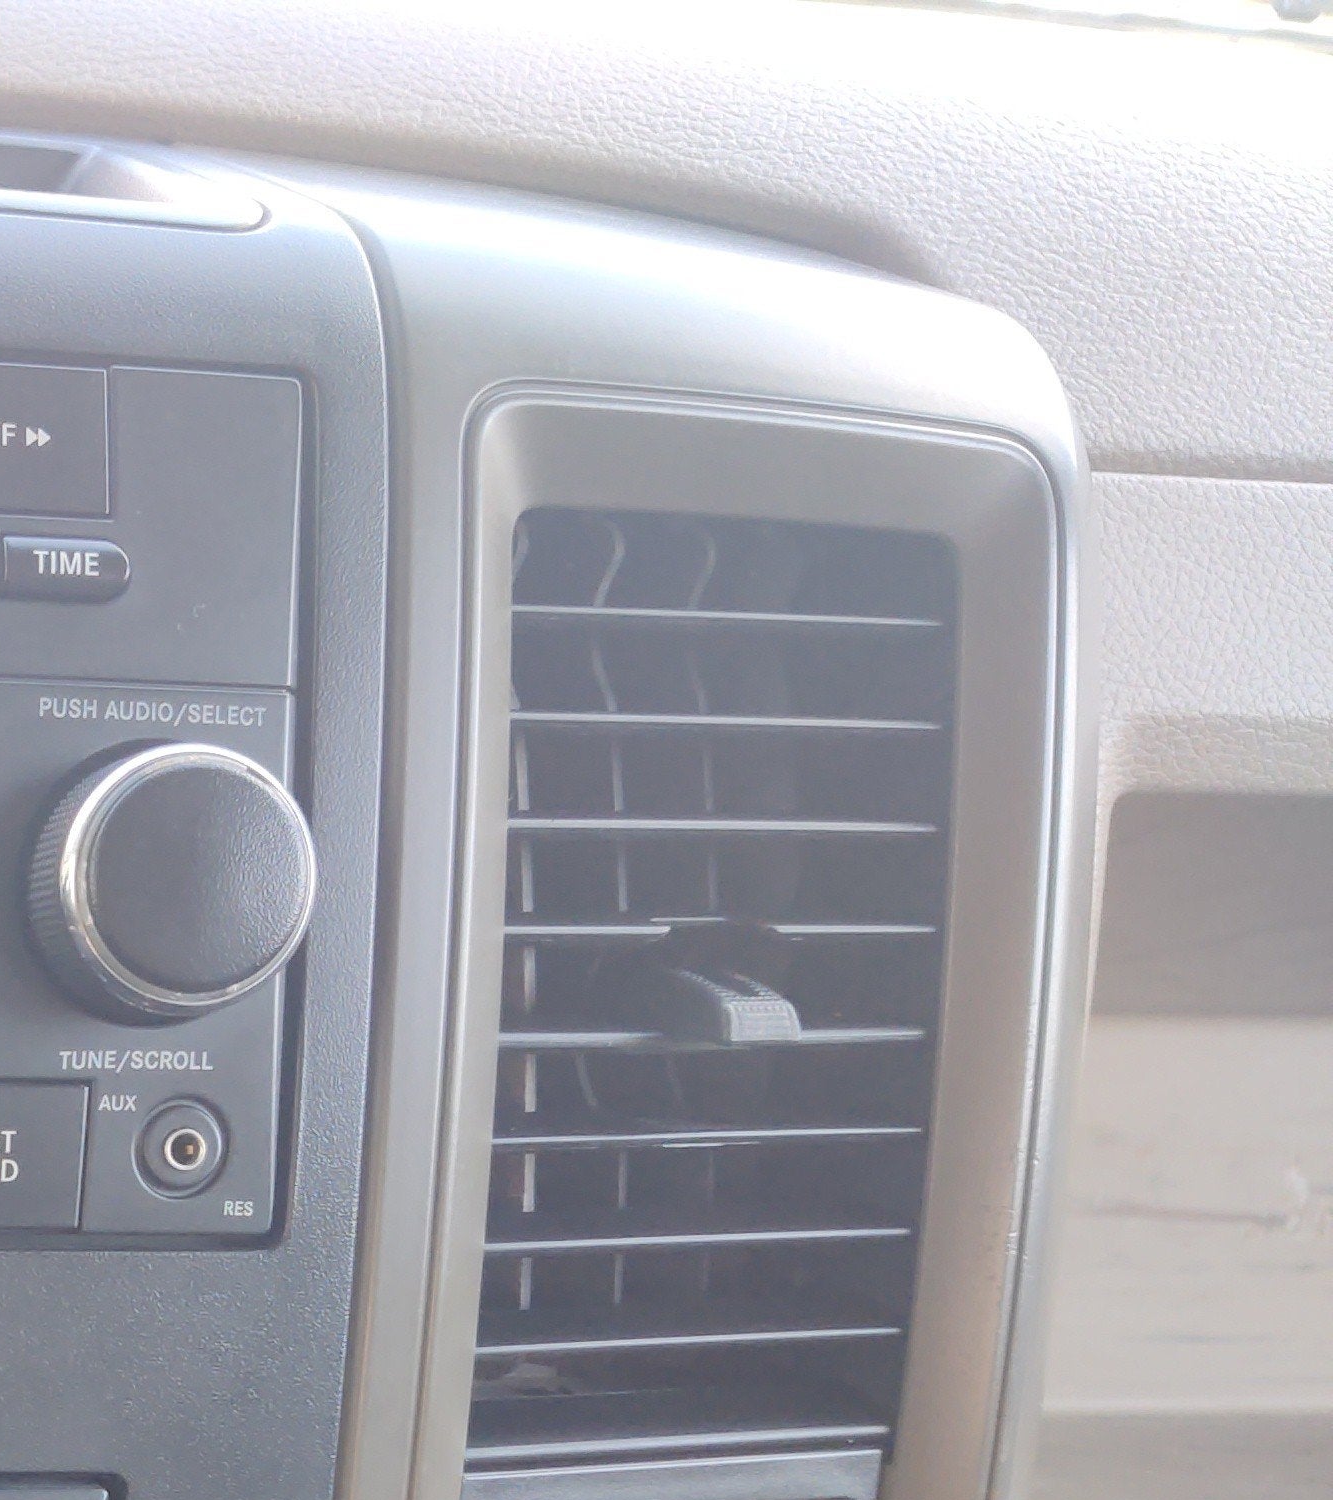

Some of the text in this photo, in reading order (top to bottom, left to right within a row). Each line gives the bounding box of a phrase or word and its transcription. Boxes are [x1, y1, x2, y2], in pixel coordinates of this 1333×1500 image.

[32, 548, 102, 578] TIME
[39, 697, 269, 728] PUSH AUDIO/SELECT
[58, 1049, 214, 1074] TUNE/SCROLL
[97, 1094, 138, 1112] AUX
[223, 1200, 254, 1217] RES
